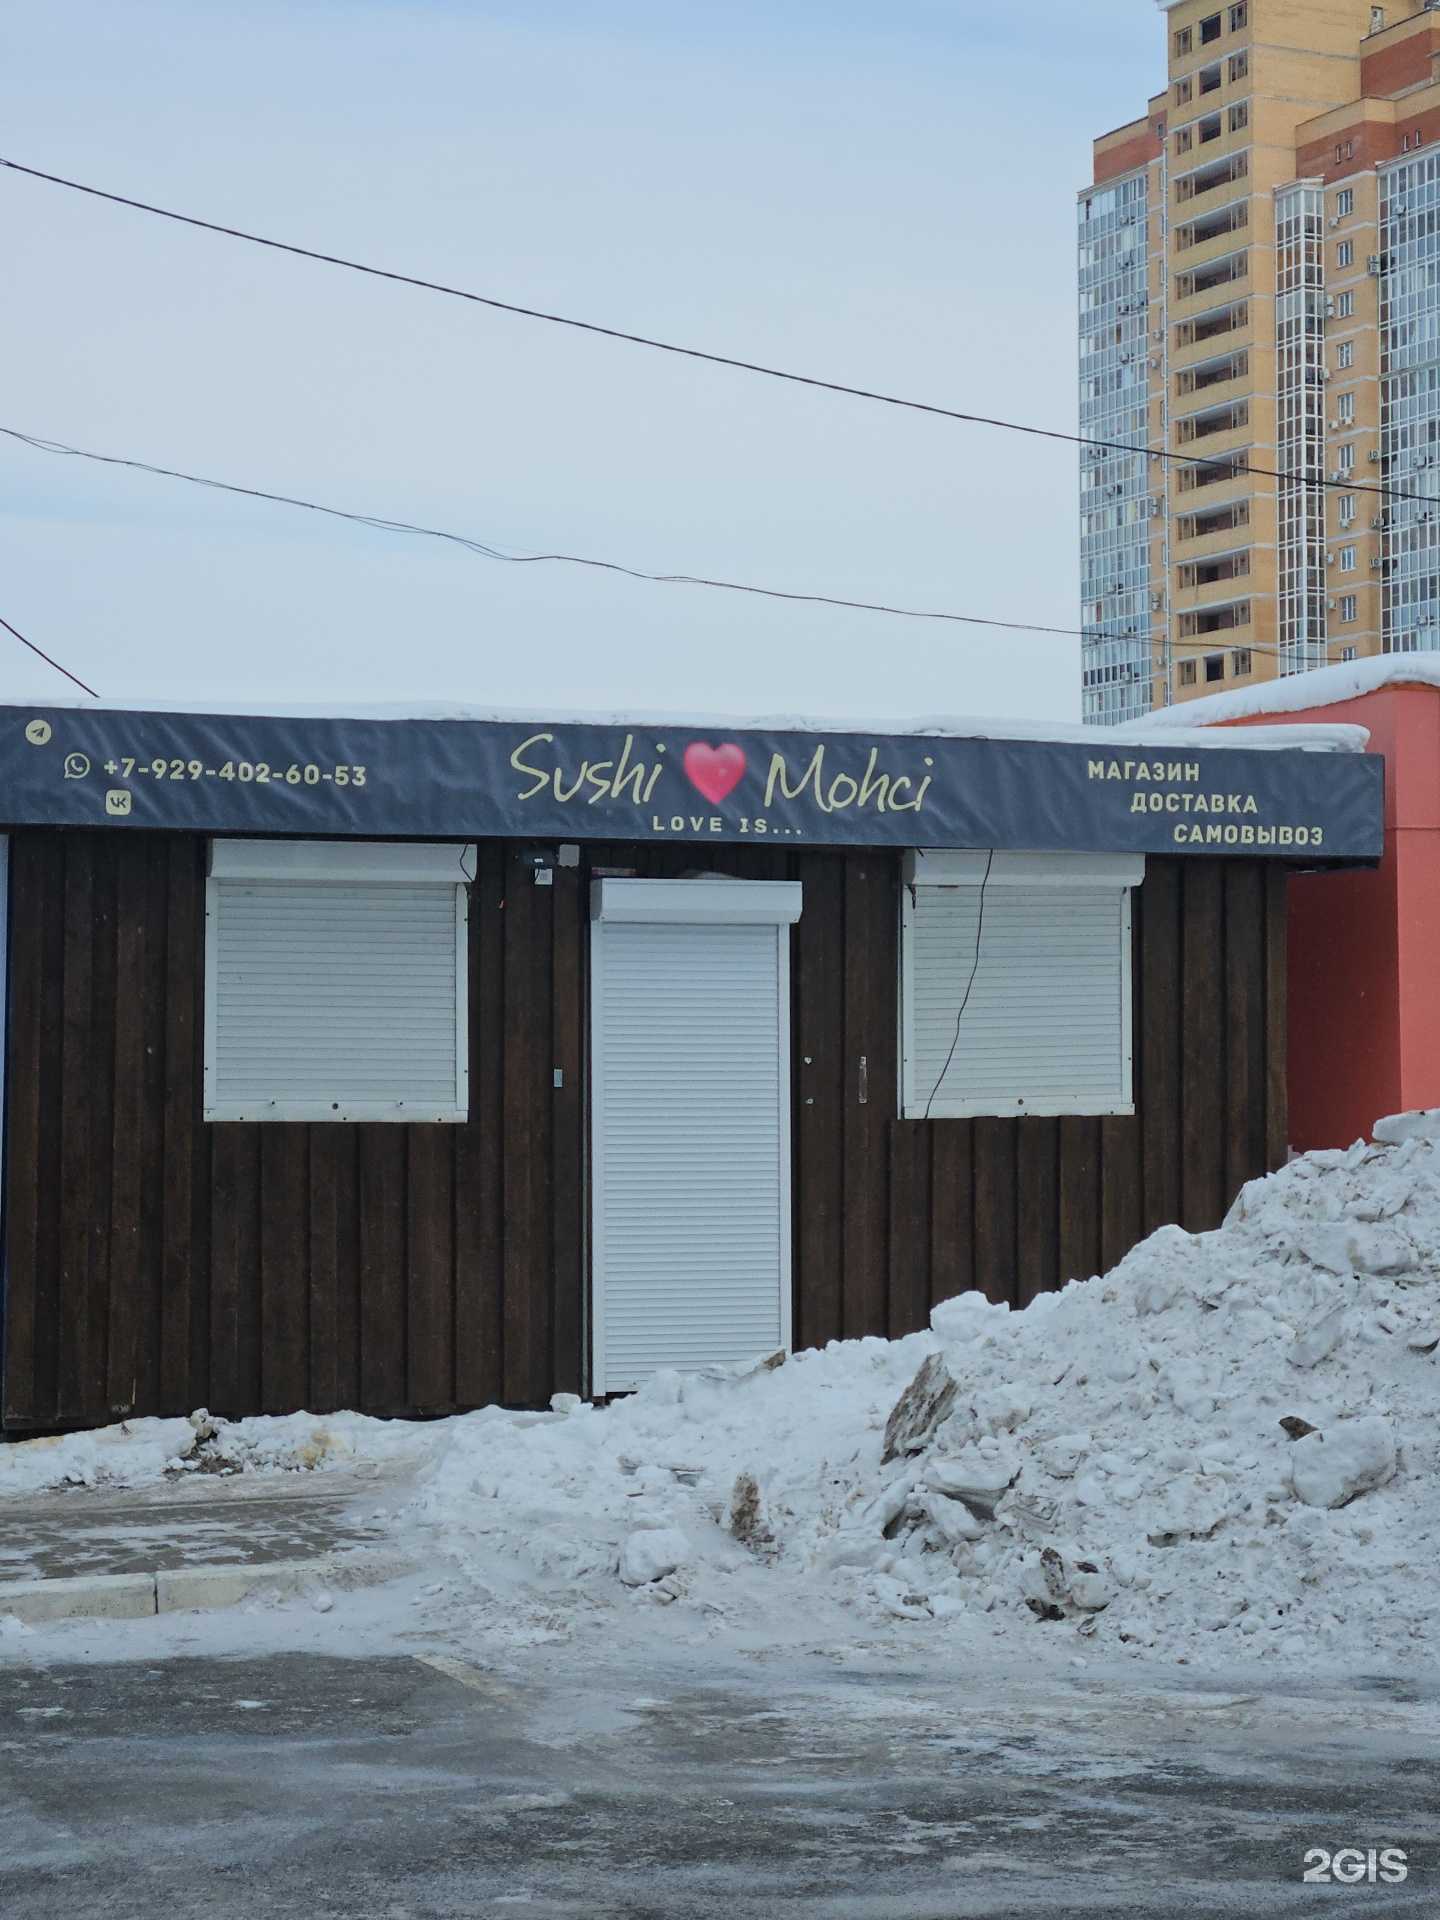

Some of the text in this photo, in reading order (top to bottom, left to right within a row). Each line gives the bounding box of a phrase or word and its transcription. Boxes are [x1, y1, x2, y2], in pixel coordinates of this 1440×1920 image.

[104, 757, 367, 786] +7-929-402-60-53
[510, 733, 666, 804] Sushi
[1087, 760, 1200, 782] МАГАЗИН
[1130, 792, 1258, 814] ДОСТАВКА
[652, 815, 802, 835] LOVE IS...
[1173, 823, 1323, 846] САМОВЫВОЗ
